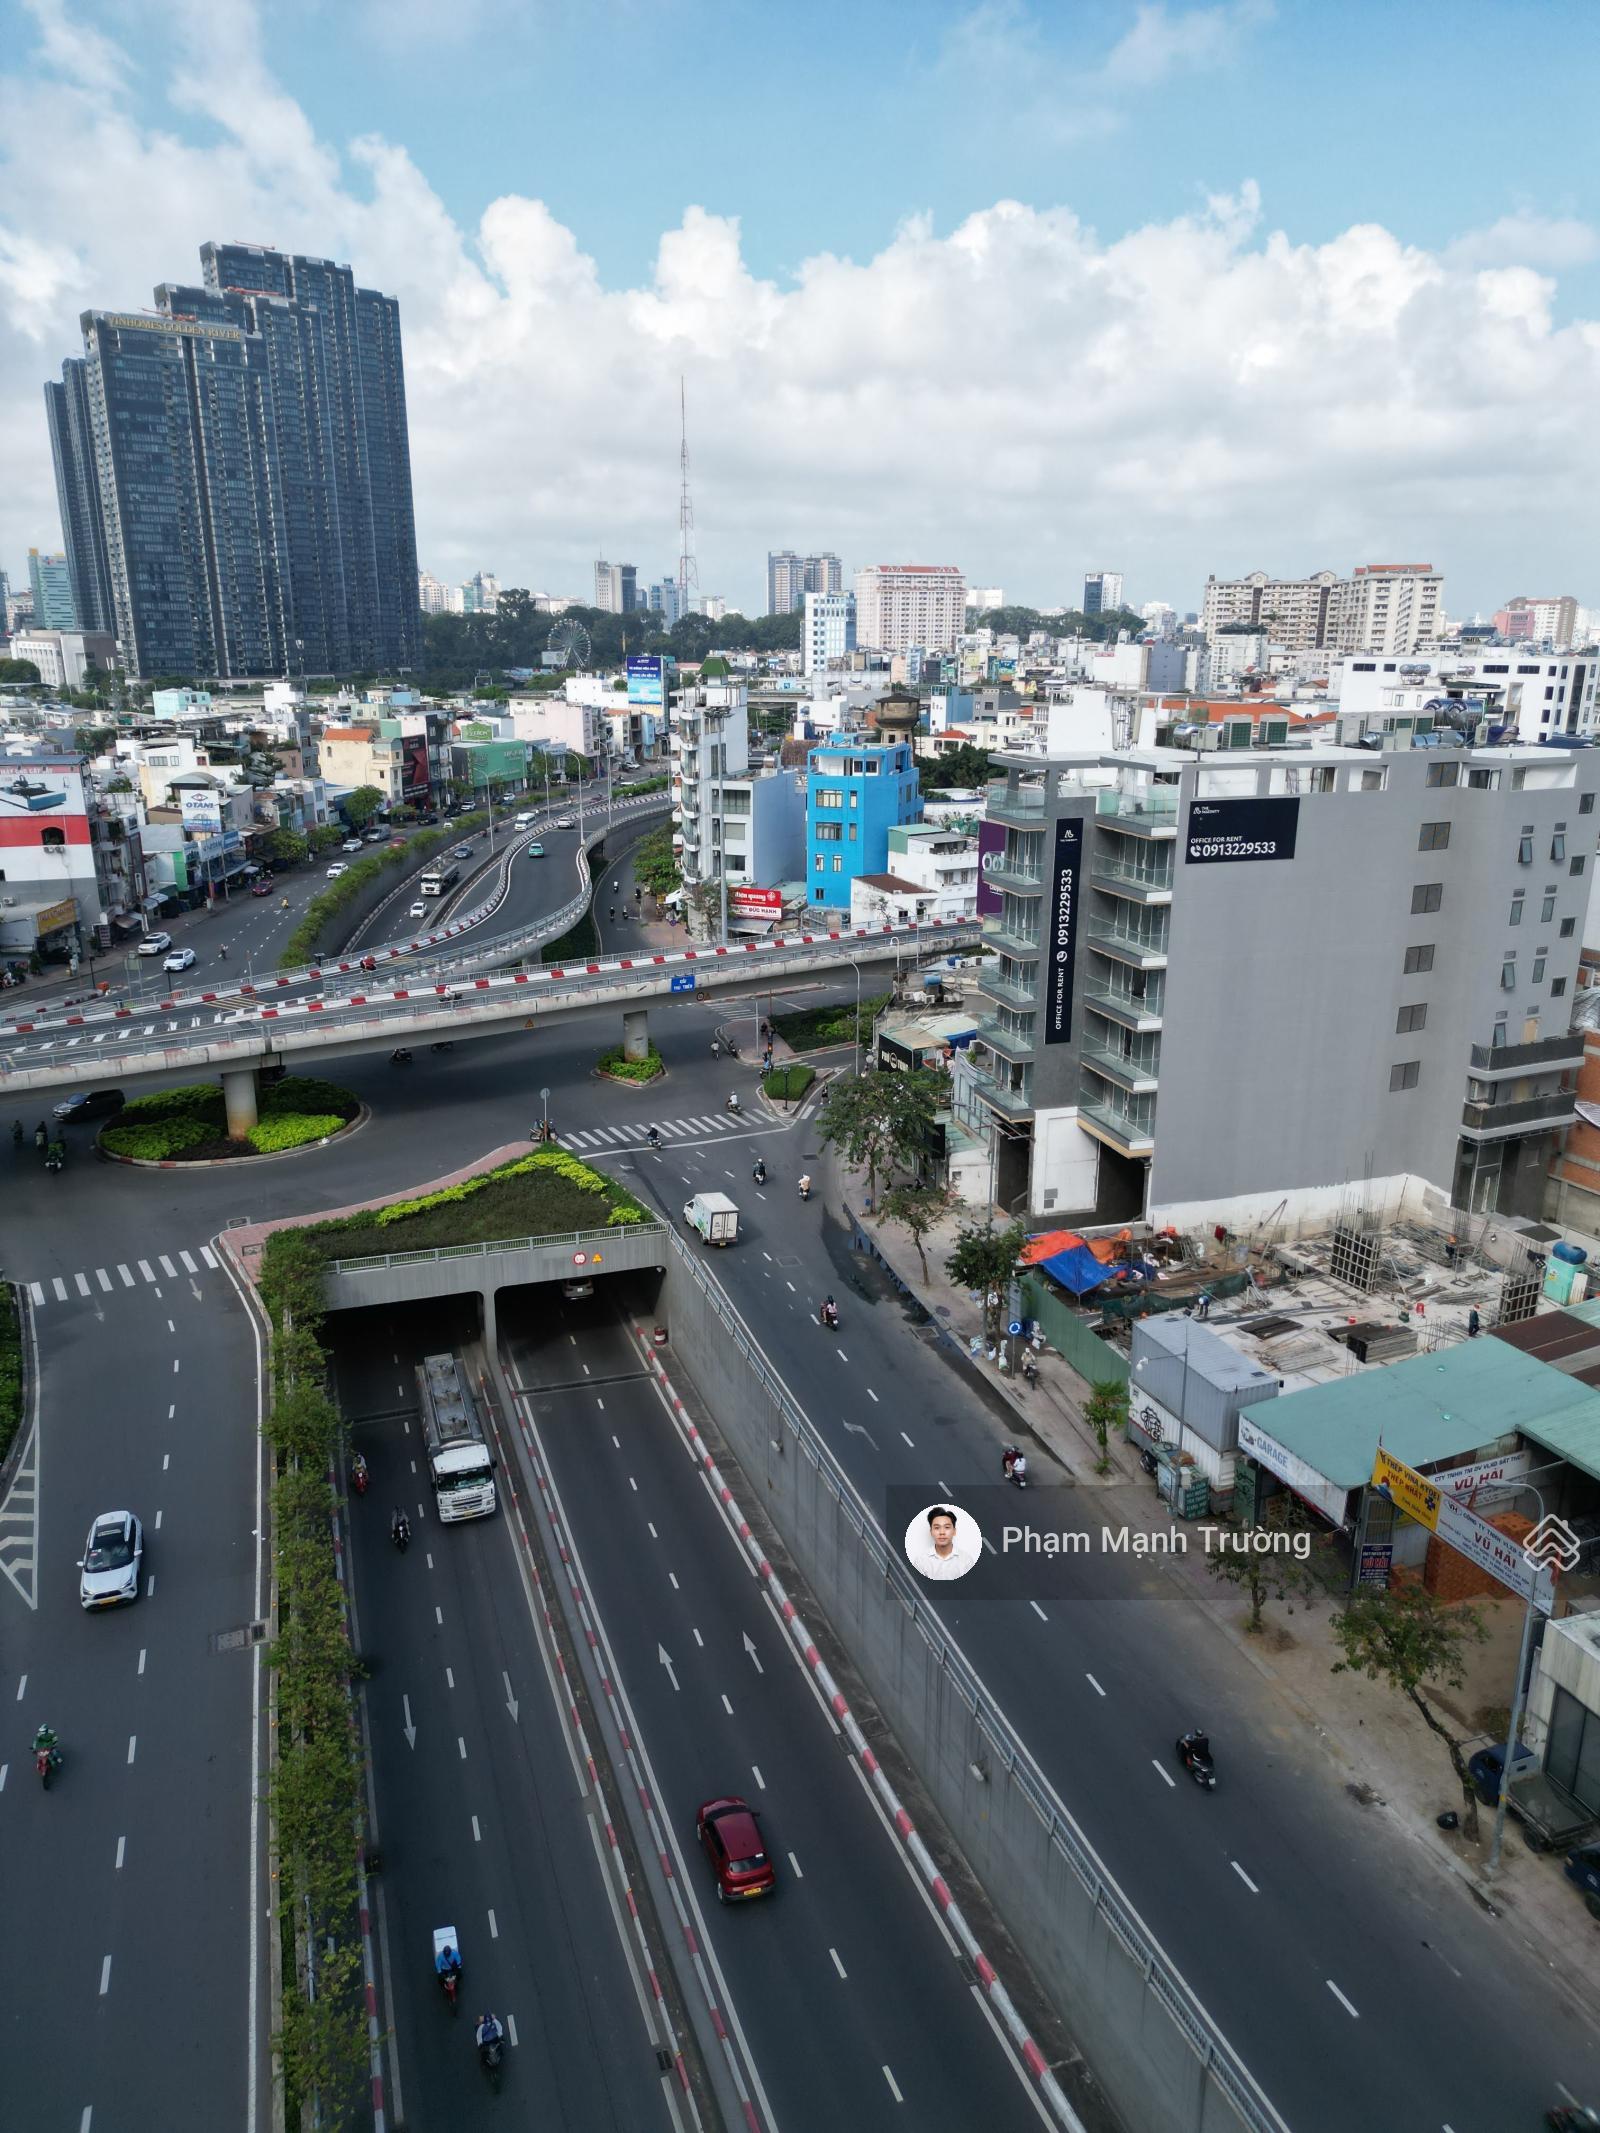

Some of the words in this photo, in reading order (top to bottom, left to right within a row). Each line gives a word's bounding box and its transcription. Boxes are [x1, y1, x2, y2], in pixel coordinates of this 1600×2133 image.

[110, 316, 162, 329] VINHOMES
[163, 323, 205, 335] GOLDEN
[208, 328, 240, 339] RIVER
[1202, 841, 1276, 857] 0913229533
[1226, 835, 1243, 843] RENT
[1057, 868, 1073, 945] 0913229533
[1057, 967, 1065, 987] RENT
[1056, 987, 1064, 1003] FOR
[1055, 1004, 1063, 1030] OFFICE
[1257, 1437, 1288, 1468] GARAGE
[1404, 1470, 1419, 1486] VINA
[1435, 1474, 1446, 1482] CTY
[1447, 1470, 1463, 1479] TNHH
[1454, 1475, 1474, 1491] VŨ
[1479, 1468, 1504, 1484] HẢI
[1463, 1512, 1477, 1525] CÔNG
[1474, 1531, 1490, 1550] VŨ
[1494, 1547, 1517, 1569] HẢI
